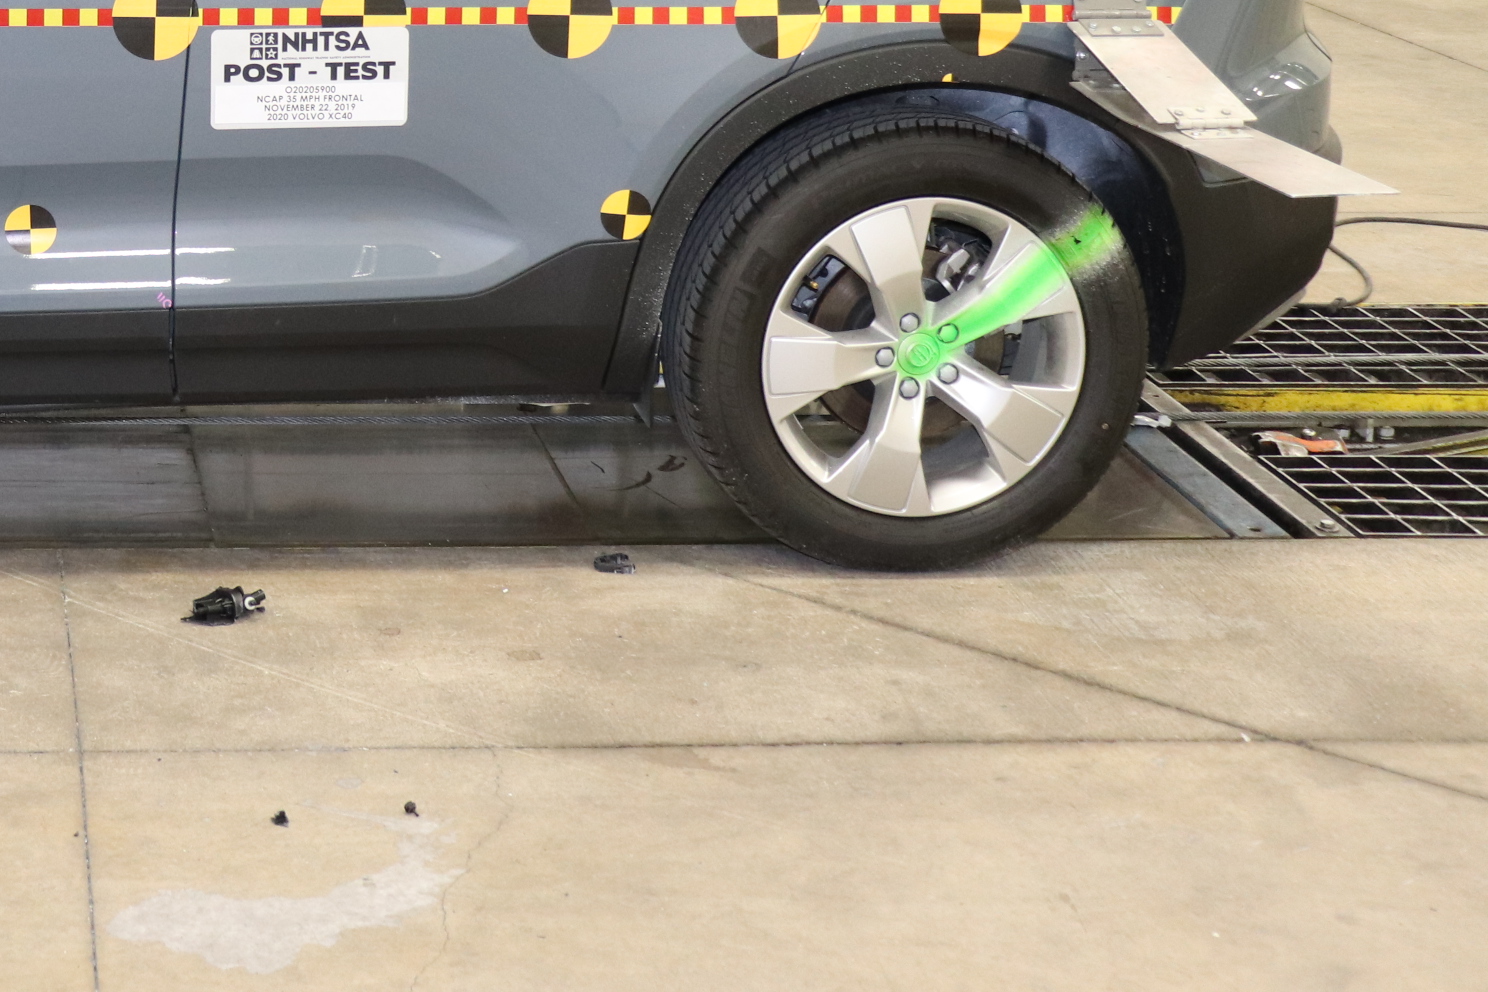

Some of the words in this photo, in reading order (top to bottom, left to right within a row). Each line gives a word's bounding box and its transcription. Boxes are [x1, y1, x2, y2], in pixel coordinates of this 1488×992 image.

[282, 30, 370, 52] NHTSA
[223, 63, 301, 83] POST
[325, 61, 396, 81] TEST
[256, 95, 284, 103] NCAP
[286, 95, 297, 103] 35
[300, 94, 320, 103] MPH
[323, 94, 364, 102] FRONTAL
[264, 103, 315, 112] NOVEMBER
[335, 103, 356, 111] 2019
[267, 113, 289, 121] 2020
[291, 113, 325, 121] VOLVO
[328, 112, 353, 120] XC40
